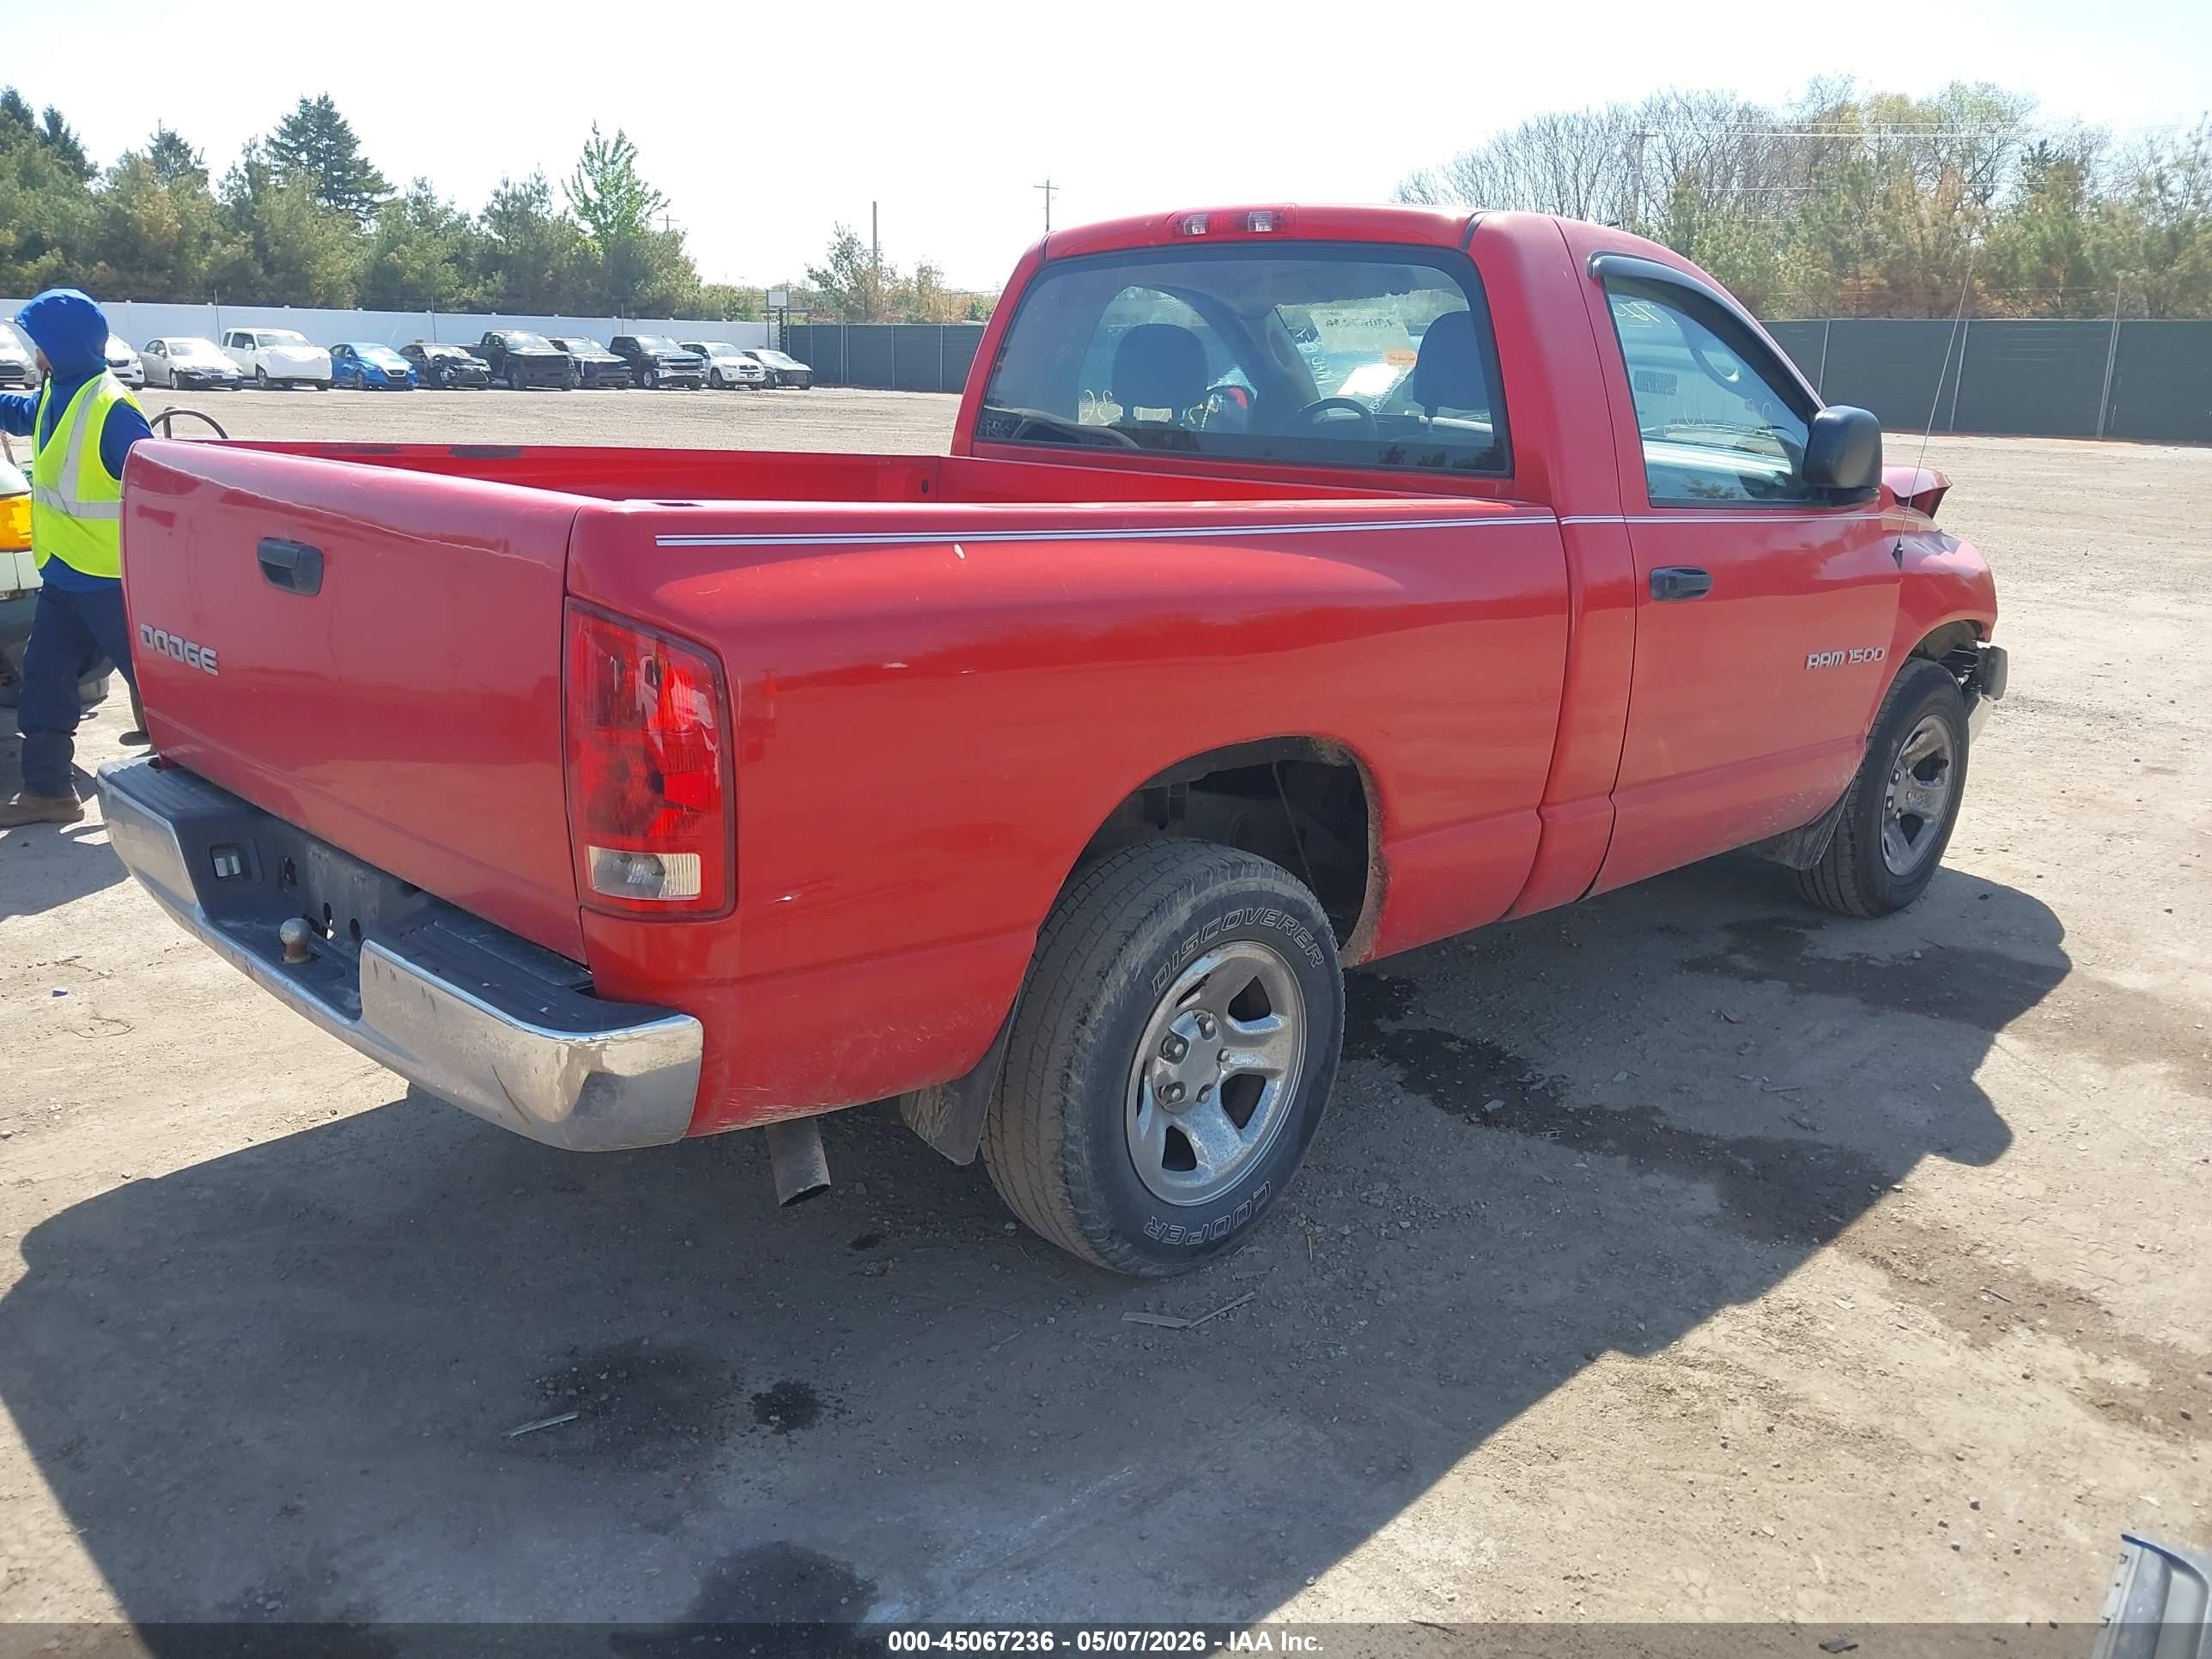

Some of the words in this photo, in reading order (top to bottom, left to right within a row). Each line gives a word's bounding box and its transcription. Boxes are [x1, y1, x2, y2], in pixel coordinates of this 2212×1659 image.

[140, 623, 219, 676] DODGE
[1806, 650, 1844, 670] RAM
[1848, 647, 1886, 665] 1500
[1151, 907, 1325, 997] DISCOVERER
[1143, 1181, 1272, 1246] COOPER
